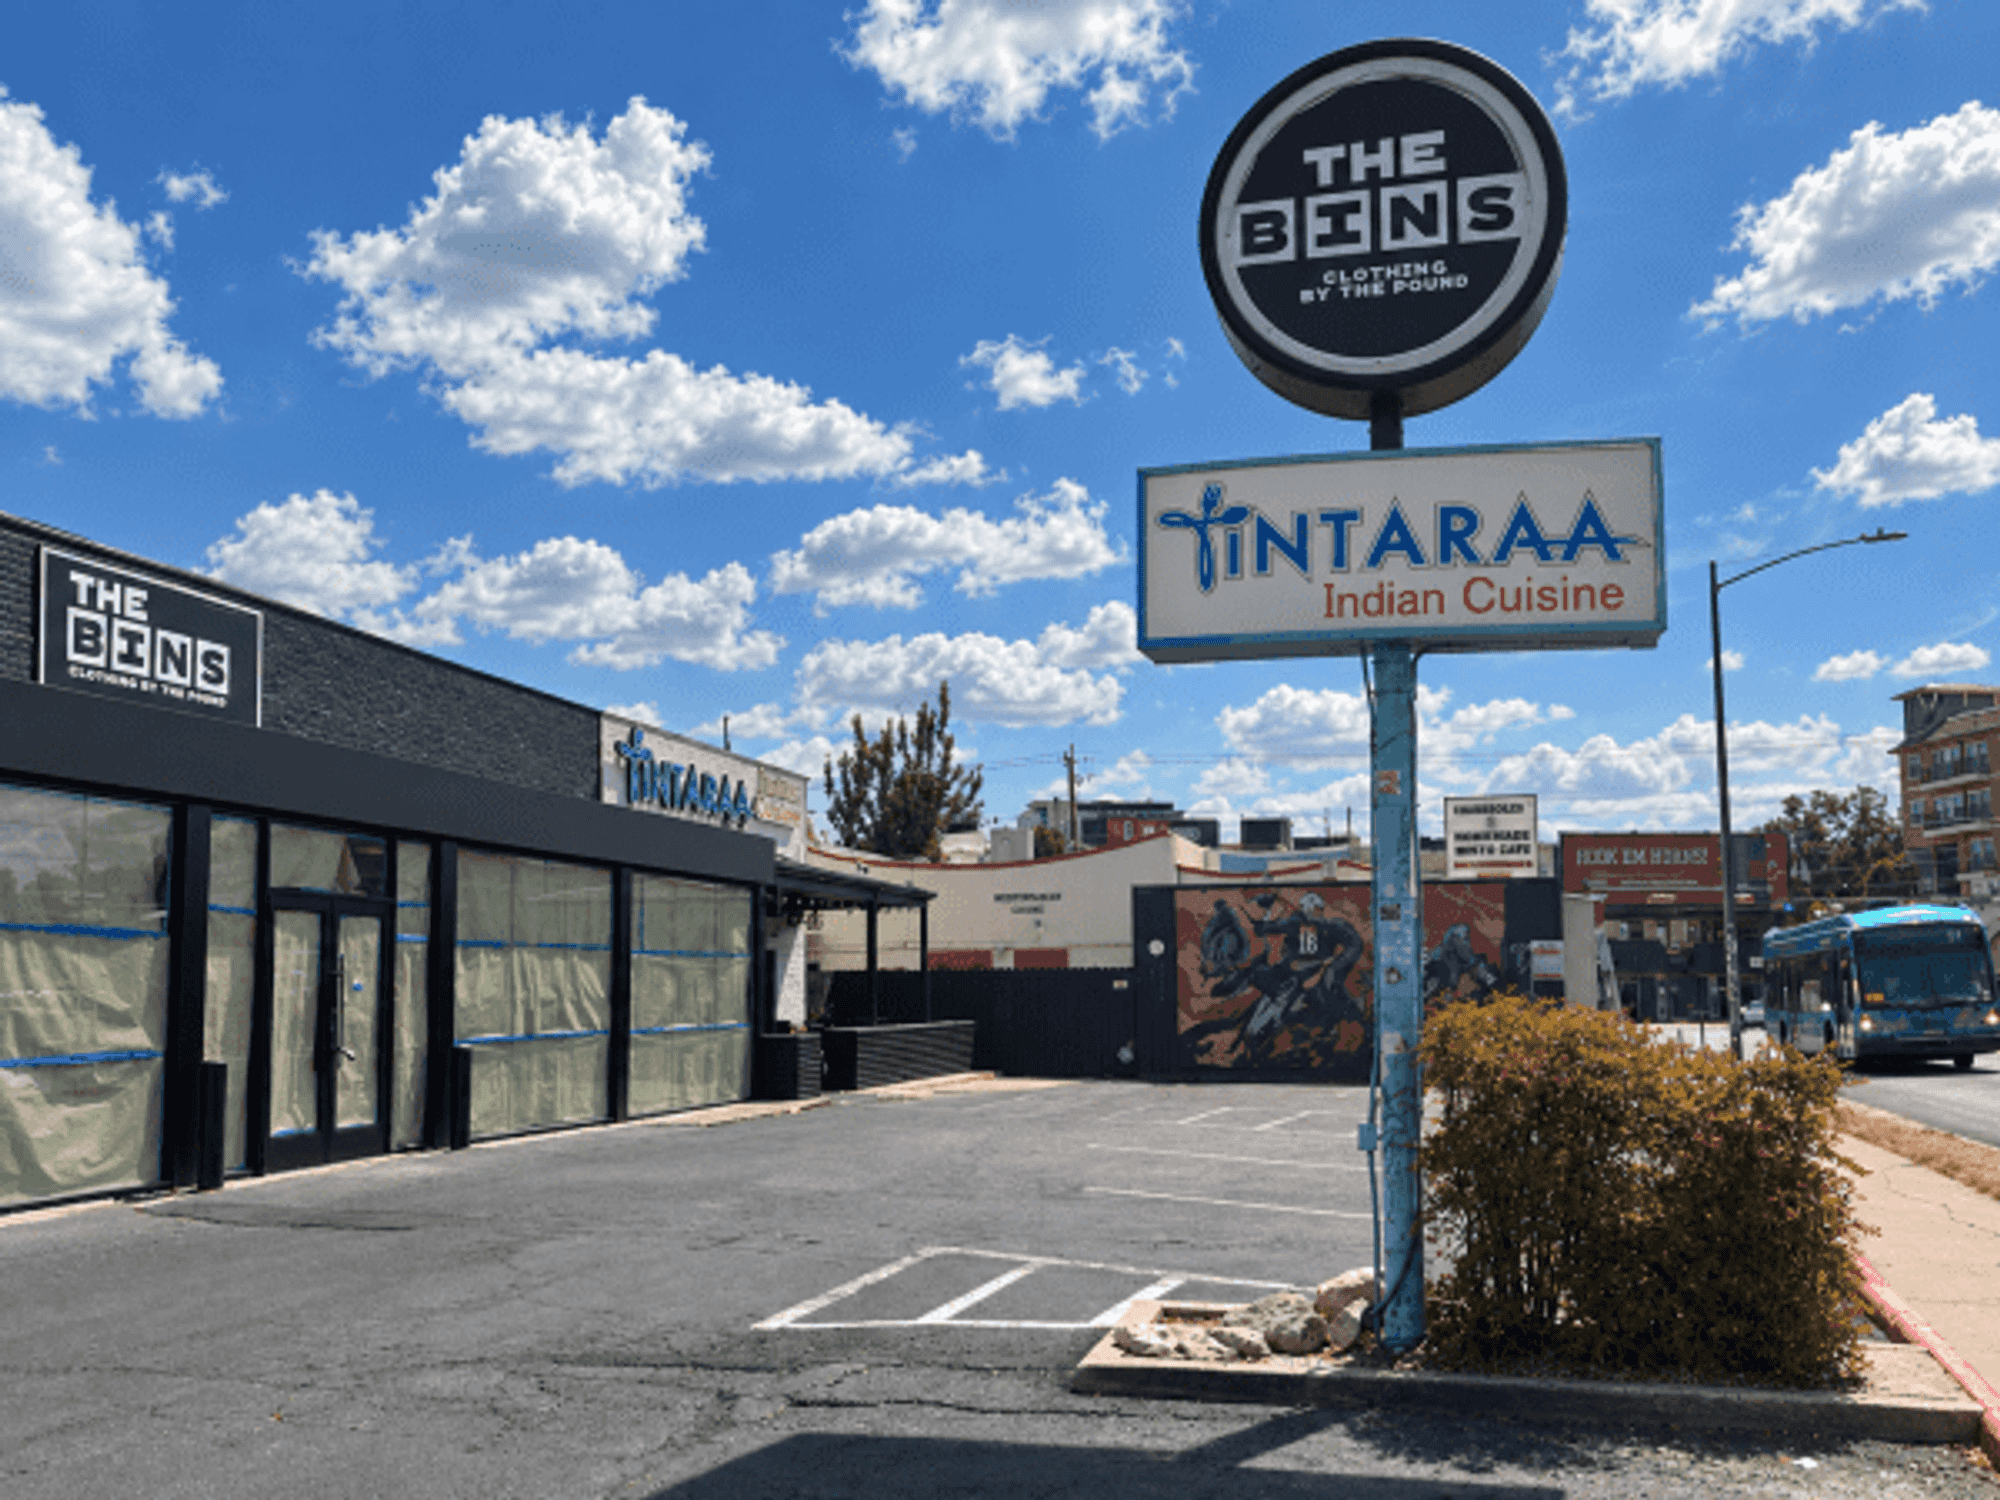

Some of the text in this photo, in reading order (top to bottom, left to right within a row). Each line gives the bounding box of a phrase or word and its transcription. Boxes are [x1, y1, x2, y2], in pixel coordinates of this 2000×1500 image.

[1303, 130, 1446, 187] THE
[1237, 175, 1521, 264] BINS
[1300, 273, 1468, 303] BY THE POUND
[1323, 259, 1447, 285] CLOTHING
[70, 570, 148, 621] THE
[1324, 575, 1625, 618] Indian Cuisine
[68, 608, 229, 692] BINS
